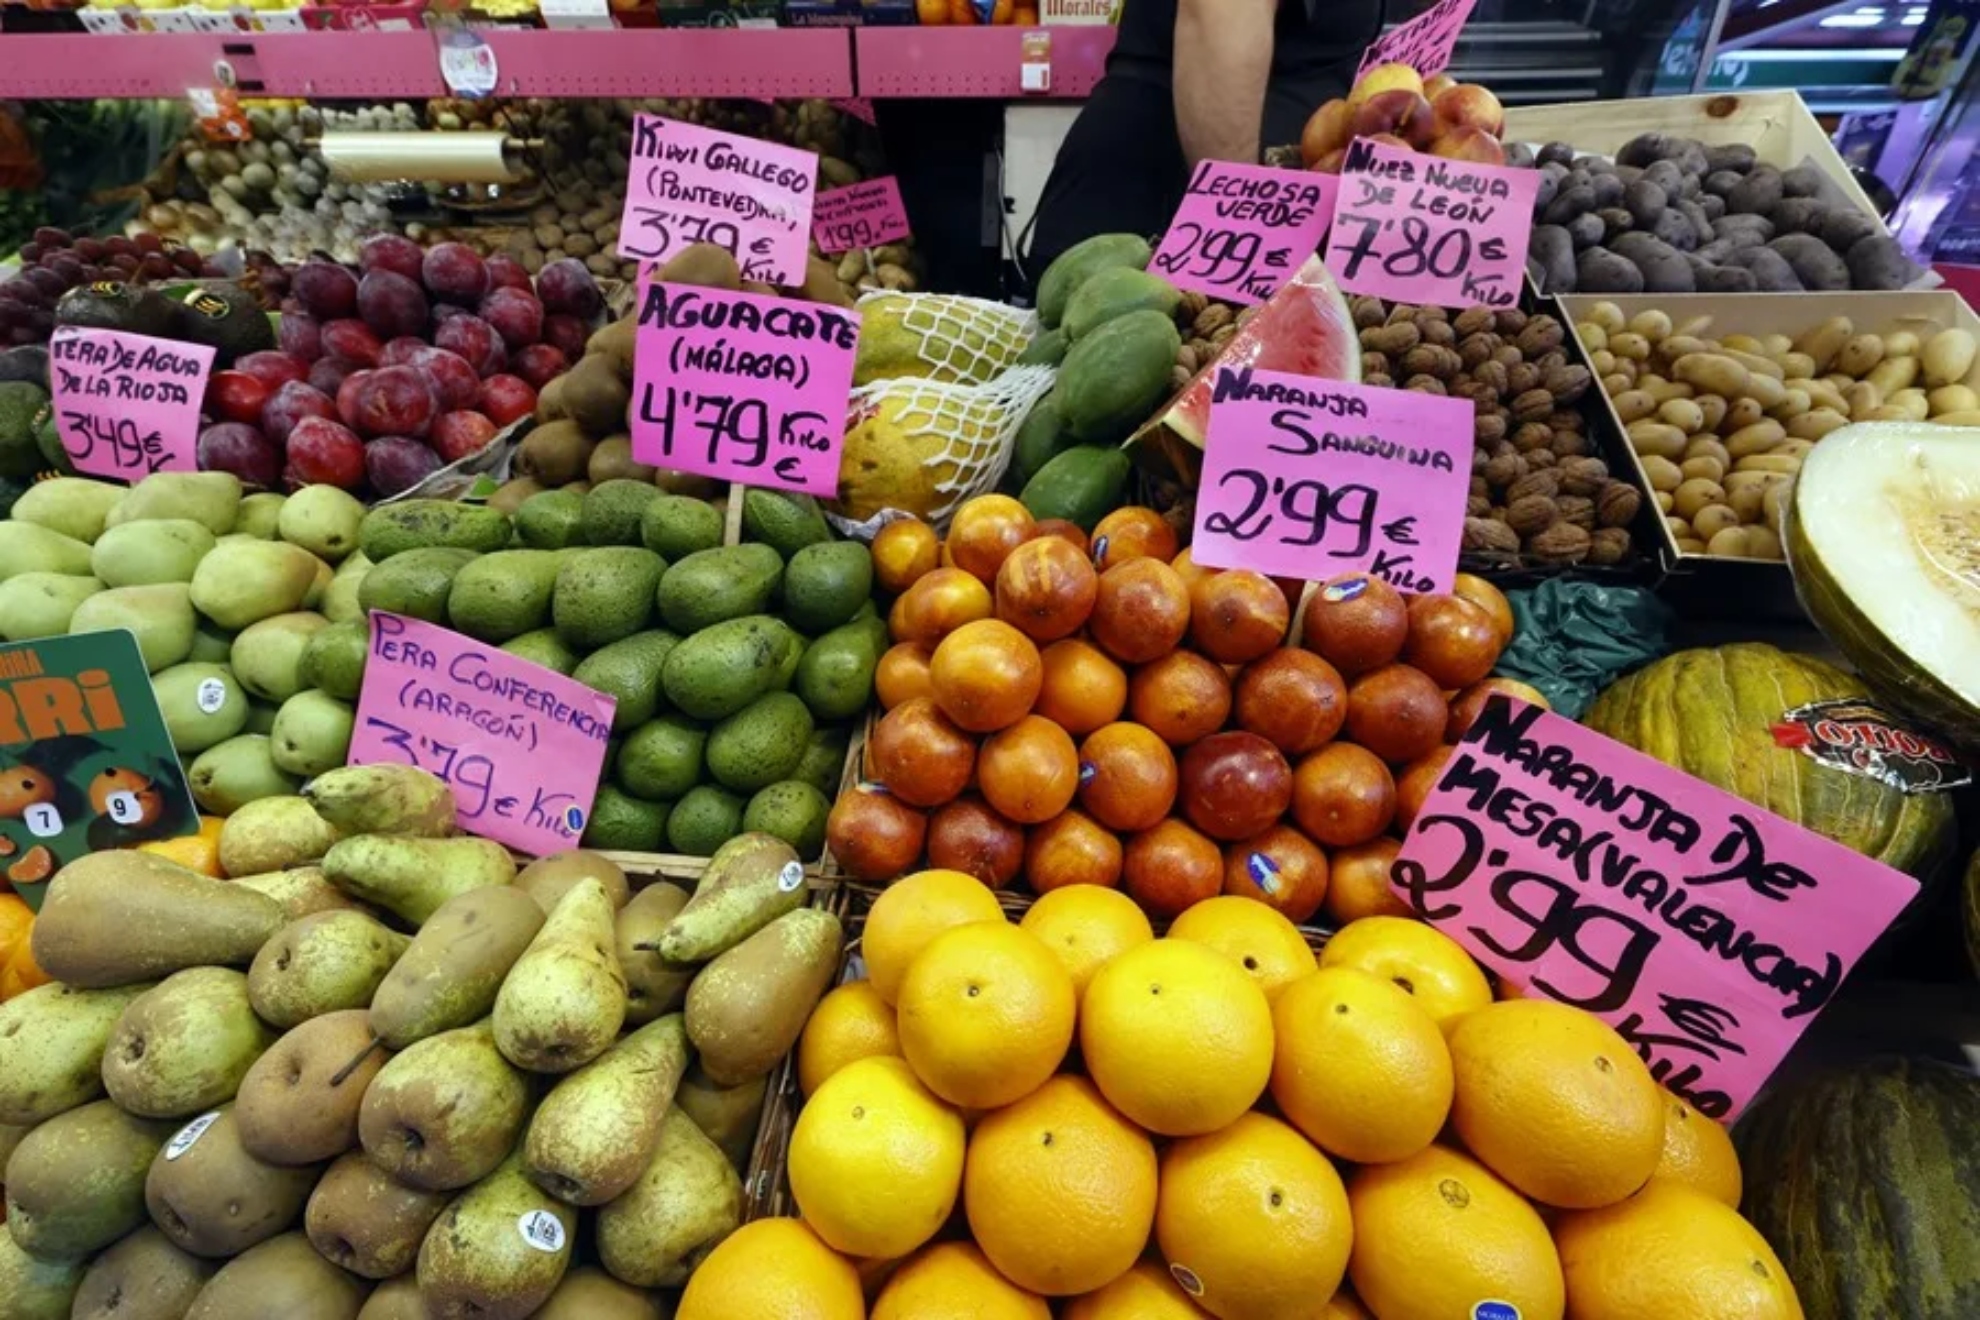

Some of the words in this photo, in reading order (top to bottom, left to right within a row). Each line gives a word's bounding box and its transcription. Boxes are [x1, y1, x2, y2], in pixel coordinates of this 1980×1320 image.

[704, 142, 808, 194] GALLEGO
[1187, 162, 1320, 206] LECHOSA
[1344, 140, 1415, 182] NUEZ
[1425, 163, 1509, 198] NUEVA
[1352, 179, 1396, 207] DE
[625, 206, 739, 258] 3'79
[750, 237, 774, 254] €
[1216, 201, 1314, 227] VERDE
[1156, 222, 1262, 284] 2'99
[1264, 248, 1292, 268] €
[1333, 213, 1471, 280] 7'80
[1479, 238, 1508, 260] €
[638, 283, 861, 350] AGUACATE
[103, 339, 136, 374] DE
[136, 345, 200, 376] AGUA
[669, 336, 810, 389] (MÁLAGA)
[57, 366, 81, 394] DE
[85, 375, 110, 397] LA
[115, 376, 188, 405] RIOJA
[1212, 367, 1368, 418] NARANJA
[61, 411, 143, 467] 3'49
[143, 431, 163, 454] €
[640, 382, 769, 467] 4'79
[1267, 410, 1453, 472] SANGUINA
[774, 457, 808, 484] €
[1204, 469, 1378, 557] 2'99
[1381, 516, 1420, 545] €
[373, 613, 437, 671] PERA
[449, 653, 610, 743] CONFERENCIA
[37, 811, 49, 828] 7
[113, 798, 127, 817] 9
[494, 796, 519, 817] €
[1462, 693, 1702, 853] NARANJA
[1682, 815, 1818, 901] DE
[1390, 815, 1661, 1013] 2'99
[1659, 993, 1746, 1056] €
